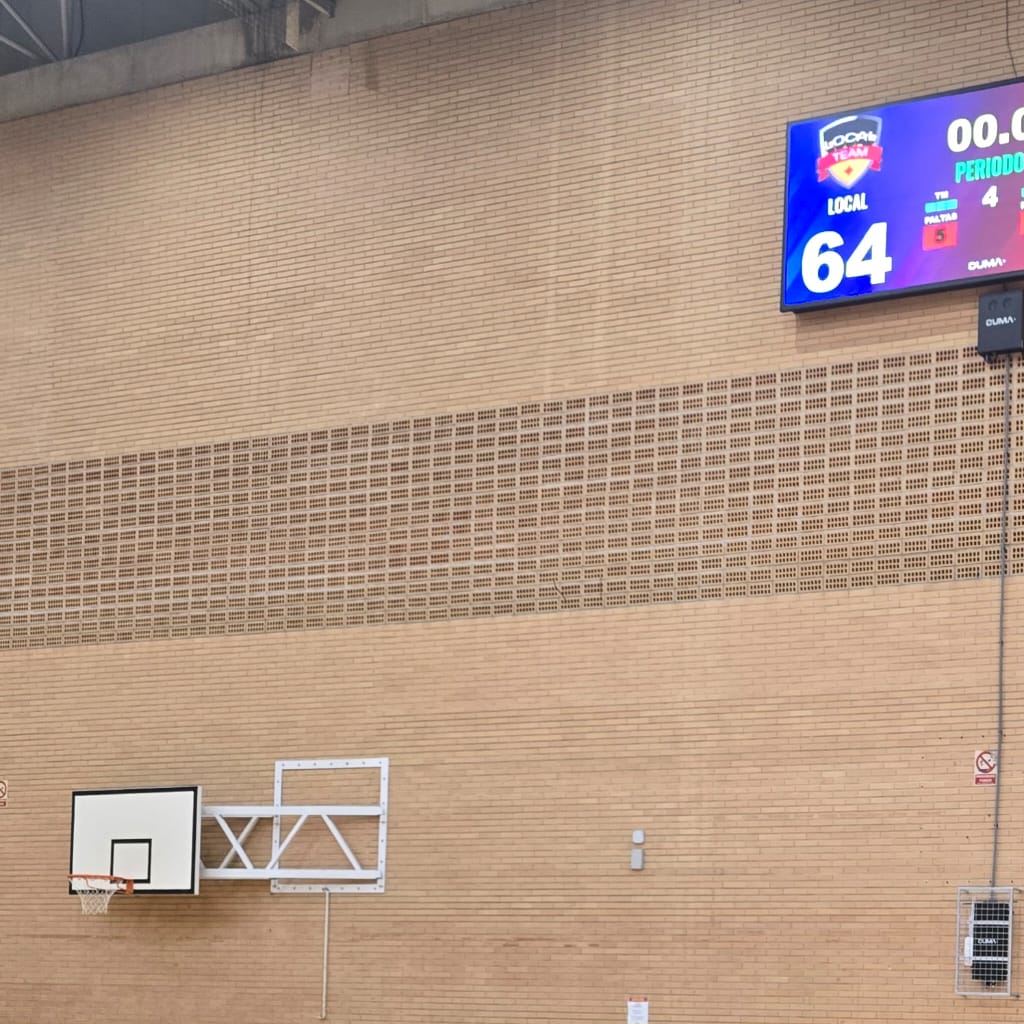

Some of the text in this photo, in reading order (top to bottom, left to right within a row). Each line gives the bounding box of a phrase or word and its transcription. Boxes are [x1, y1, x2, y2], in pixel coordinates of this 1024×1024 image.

[832, 147, 869, 162] TEAM
[827, 193, 868, 216] LOCAL
[981, 185, 999, 207] 4
[935, 229, 945, 242] 5
[801, 222, 893, 293] 64
